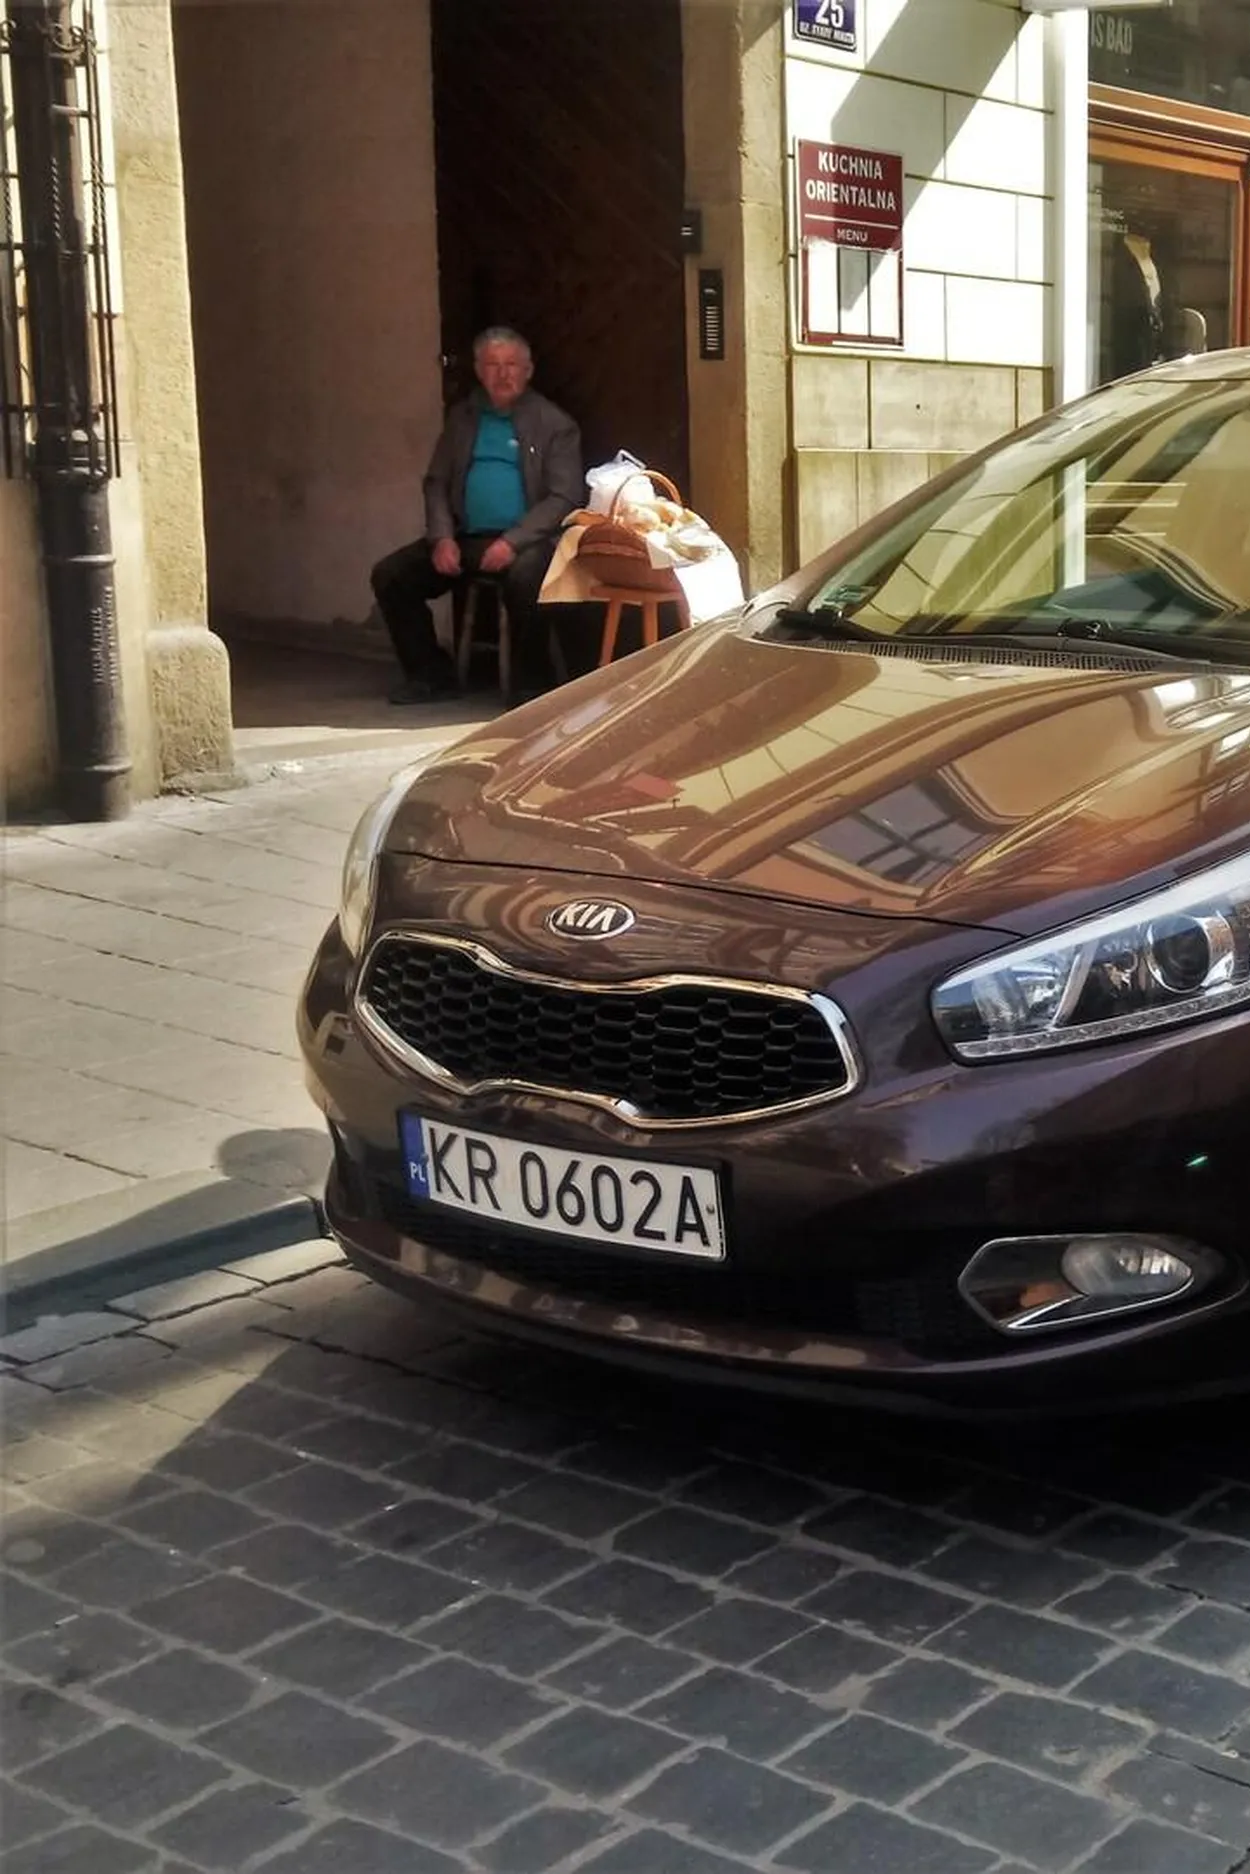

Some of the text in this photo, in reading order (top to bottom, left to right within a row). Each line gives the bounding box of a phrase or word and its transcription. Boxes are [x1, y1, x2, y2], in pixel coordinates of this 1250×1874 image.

[815, 0, 844, 28] 25
[818, 150, 883, 180] KUCHNIA
[805, 179, 897, 211] ORIENTALNA
[836, 228, 869, 242] MENU
[555, 903, 617, 932] KIA
[410, 1165, 427, 1182] PL
[429, 1127, 711, 1247] KR 0602A
